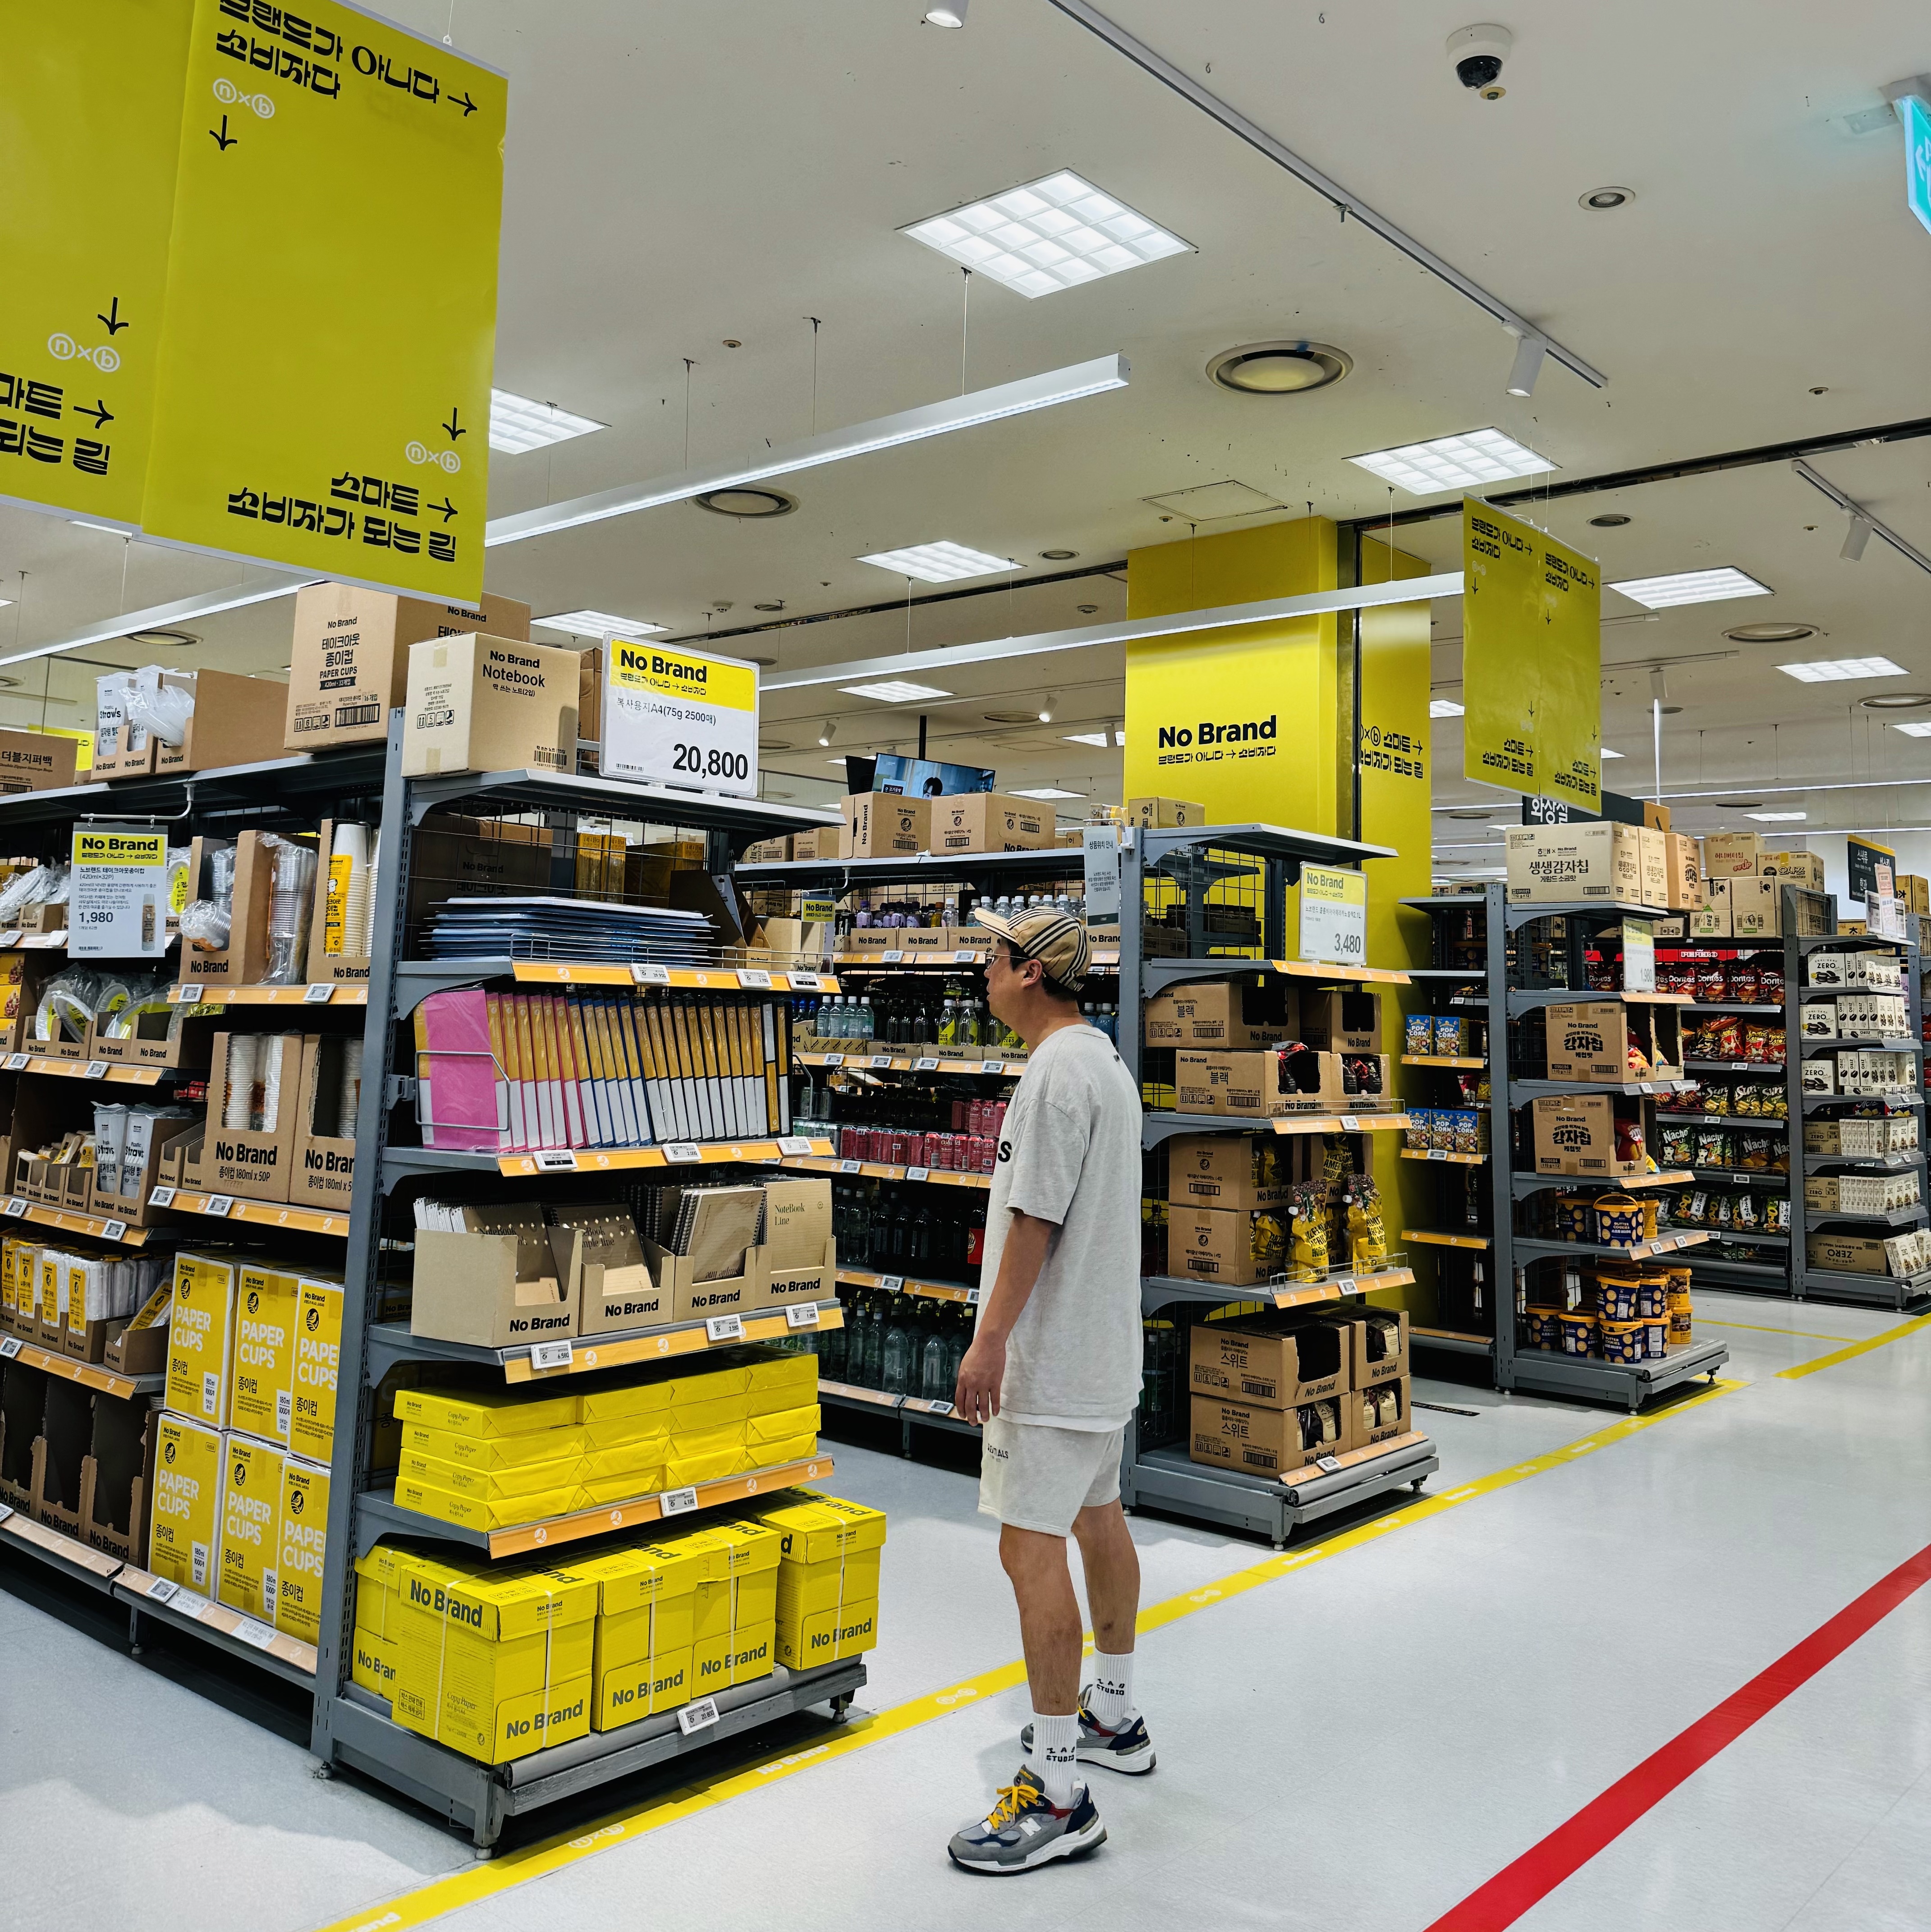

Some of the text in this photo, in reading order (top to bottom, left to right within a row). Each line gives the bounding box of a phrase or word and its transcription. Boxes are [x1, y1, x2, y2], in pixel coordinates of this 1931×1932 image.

[216, 29, 340, 100] 소비자다
[352, 45, 440, 104] 아니다
[73, 438, 111, 476] 길
[331, 471, 419, 517] 스마트
[228, 487, 456, 562] 소비자가 되는 길
[1502, 531, 1523, 552] 아니다
[328, 617, 357, 629] No Brand
[447, 606, 487, 622] No Brand
[322, 633, 360, 650] 테이크아웃
[326, 649, 353, 667] 종이컵
[490, 650, 540, 669] No Brand
[621, 649, 707, 683] No Brand
[320, 666, 358, 679] PAPER CUPS
[482, 664, 545, 688] Notebook
[500, 684, 510, 693] 쓰는
[620, 672, 706, 695] 브랜드가 아니다 소비자다
[617, 697, 716, 726] 복사용지A4(75g 2500매)
[1159, 715, 1276, 749] No Brand
[1384, 731, 1410, 753] 스마트
[1504, 738, 1524, 756] 스마트
[2, 751, 52, 766] 더블지퍼백
[168, 754, 183, 763] Brand
[673, 744, 748, 780] 20,800
[1158, 746, 1276, 765] 브랜드가 아니다 소비자다
[103, 762, 115, 770] Brand
[1394, 756, 1423, 778] 되는 길
[82, 838, 158, 851] No Brand
[1089, 840, 1113, 849] 상품위치 안내
[1529, 859, 1588, 874] 생생감자칩
[1307, 872, 1343, 889] No Brand
[79, 912, 113, 924] 1,980
[1335, 933, 1360, 955] 3,480
[191, 959, 228, 973] No Brand
[334, 966, 370, 977] No Brand
[1669, 975, 1695, 983] Doritos
[1177, 1005, 1194, 1018] 블랙
[1250, 1031, 1282, 1042] No Brand
[1564, 1036, 1603, 1051] 감자칩
[108, 1047, 122, 1055] Brand
[1211, 1071, 1229, 1084] 블랙
[1699, 1134, 1723, 1145] Nacho
[216, 1141, 277, 1165] No Brand
[219, 1166, 234, 1179] 종이컵
[236, 1169, 252, 1180] 180ml
[259, 1170, 270, 1181] 50P
[308, 1175, 341, 1190] 종이컵 180ml
[101, 1200, 114, 1210] Brand
[775, 1202, 805, 1214] NoteBook
[775, 1217, 789, 1225] Line
[252, 1278, 264, 1286] Brand
[771, 1278, 820, 1294] No Brand
[312, 1294, 325, 1302] Brand
[176, 1305, 211, 1332] PAPER
[509, 1314, 569, 1332] No Brand
[174, 1327, 203, 1352] CUPS
[241, 1320, 284, 1348] PAPER
[1230, 1340, 1248, 1349] Brand
[240, 1343, 275, 1369] CUPS
[1221, 1354, 1248, 1369] 스위트
[172, 1358, 188, 1376] 종이컵
[298, 1362, 338, 1390] CUPS
[239, 1376, 257, 1394] 종이컵
[296, 1396, 317, 1417] 종이컵
[41, 1509, 79, 1536] No Brand
[411, 1579, 431, 1606] No
[434, 1589, 482, 1628] Brand
[812, 1618, 871, 1649] No Brand
[701, 1643, 766, 1676] No Brand
[1097, 1686, 1124, 1696] STUDIO
[506, 1718, 530, 1739] No
[534, 1699, 583, 1730] Brand
[759, 1745, 830, 1775] No Brand
[1046, 1753, 1074, 1762] STUDIO
